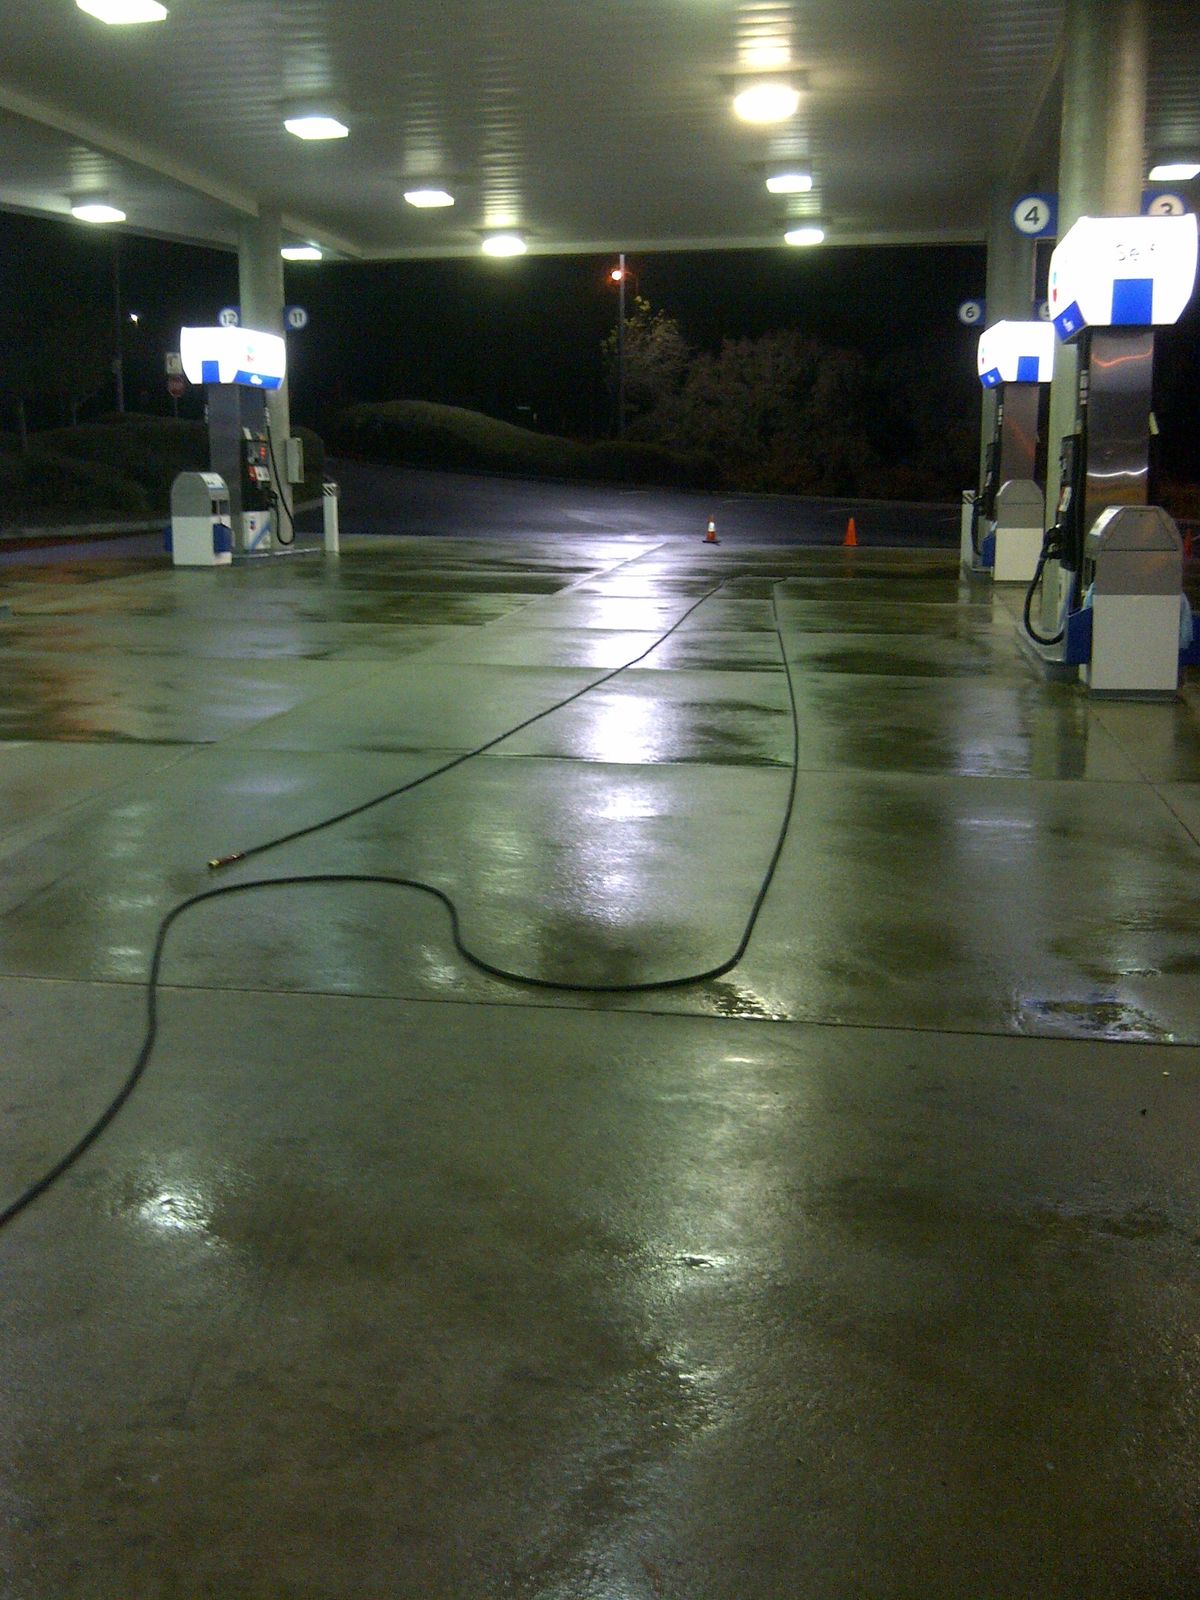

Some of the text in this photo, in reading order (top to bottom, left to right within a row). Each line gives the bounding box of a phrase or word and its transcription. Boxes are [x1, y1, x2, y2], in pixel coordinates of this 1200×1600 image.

[1024, 206, 1040, 225] 4
[293, 312, 303, 323] 11
[965, 306, 974, 318] 6
[223, 313, 236, 324] 12
